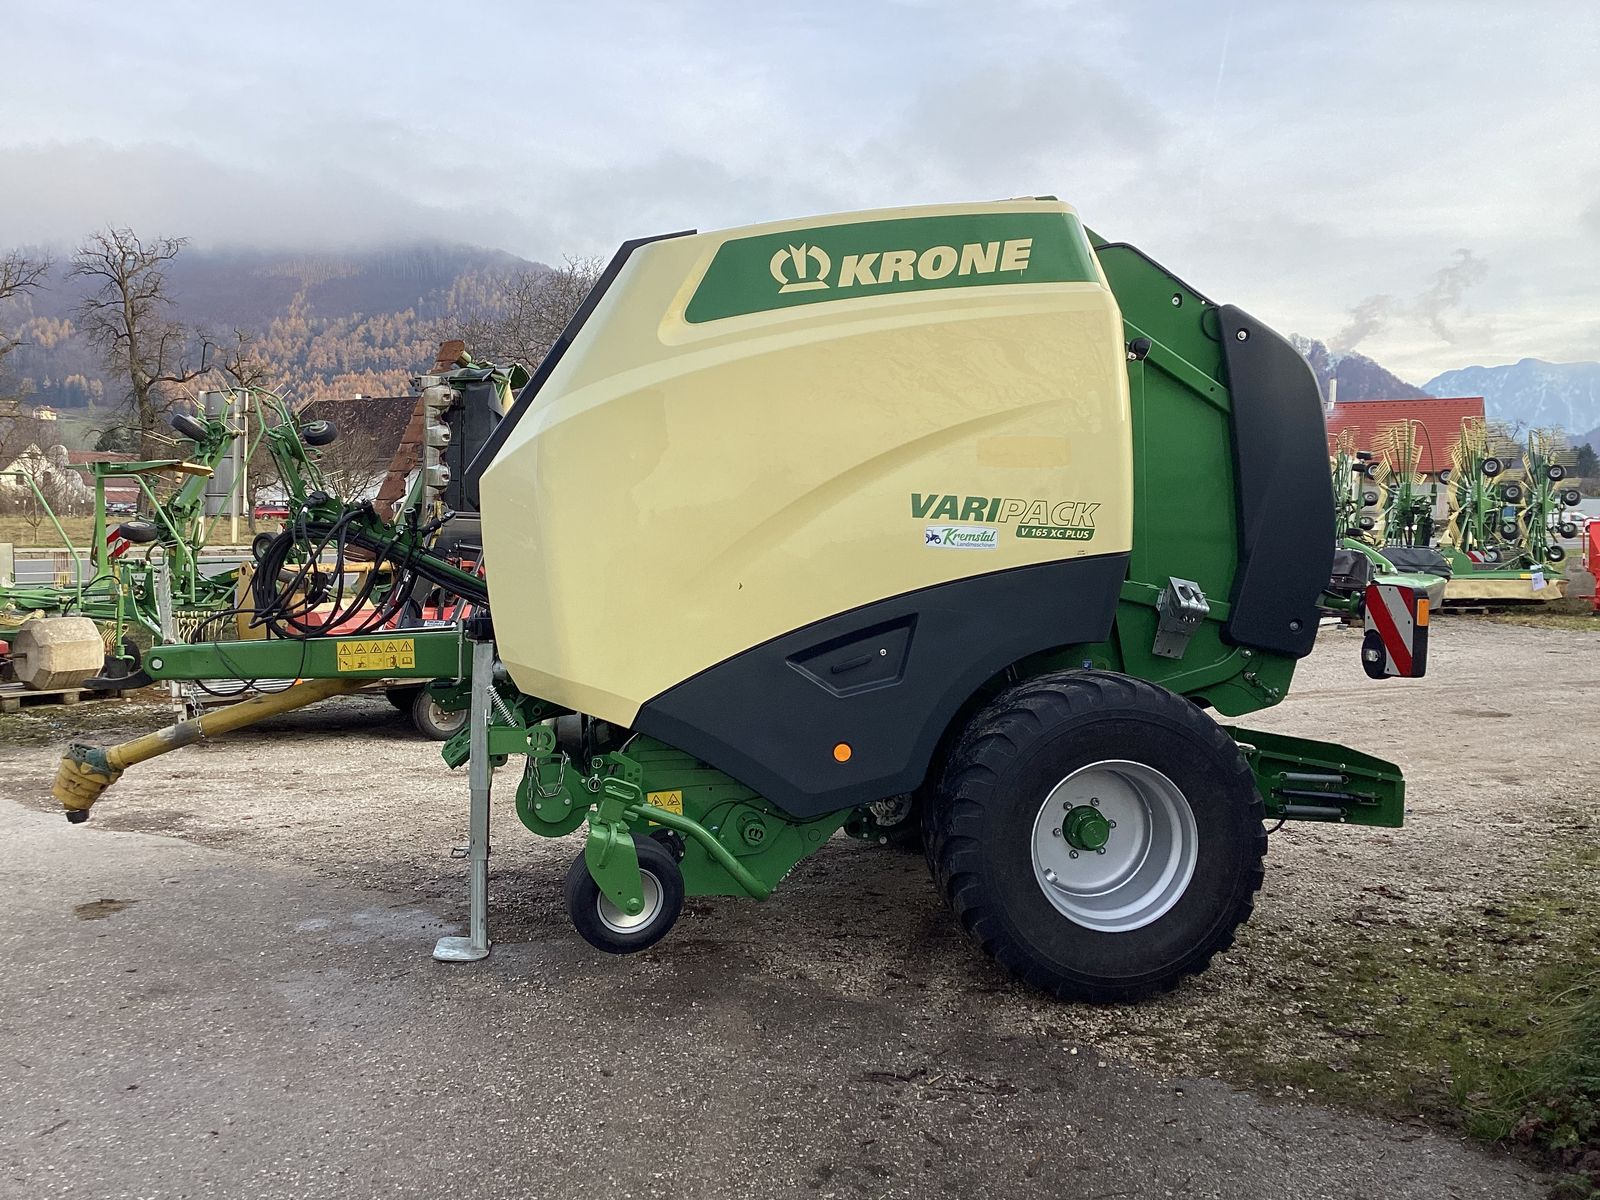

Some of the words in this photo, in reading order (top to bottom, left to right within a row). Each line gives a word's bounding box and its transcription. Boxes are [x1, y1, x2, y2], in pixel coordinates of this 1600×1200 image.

[838, 238, 1032, 288] KRONE
[911, 493, 1101, 527] VARIPACK
[942, 528, 996, 545] Kremstal
[1021, 528, 1028, 536] V
[1031, 528, 1048, 537] 165
[1050, 529, 1064, 538] XC
[1065, 530, 1089, 539] PLUS
